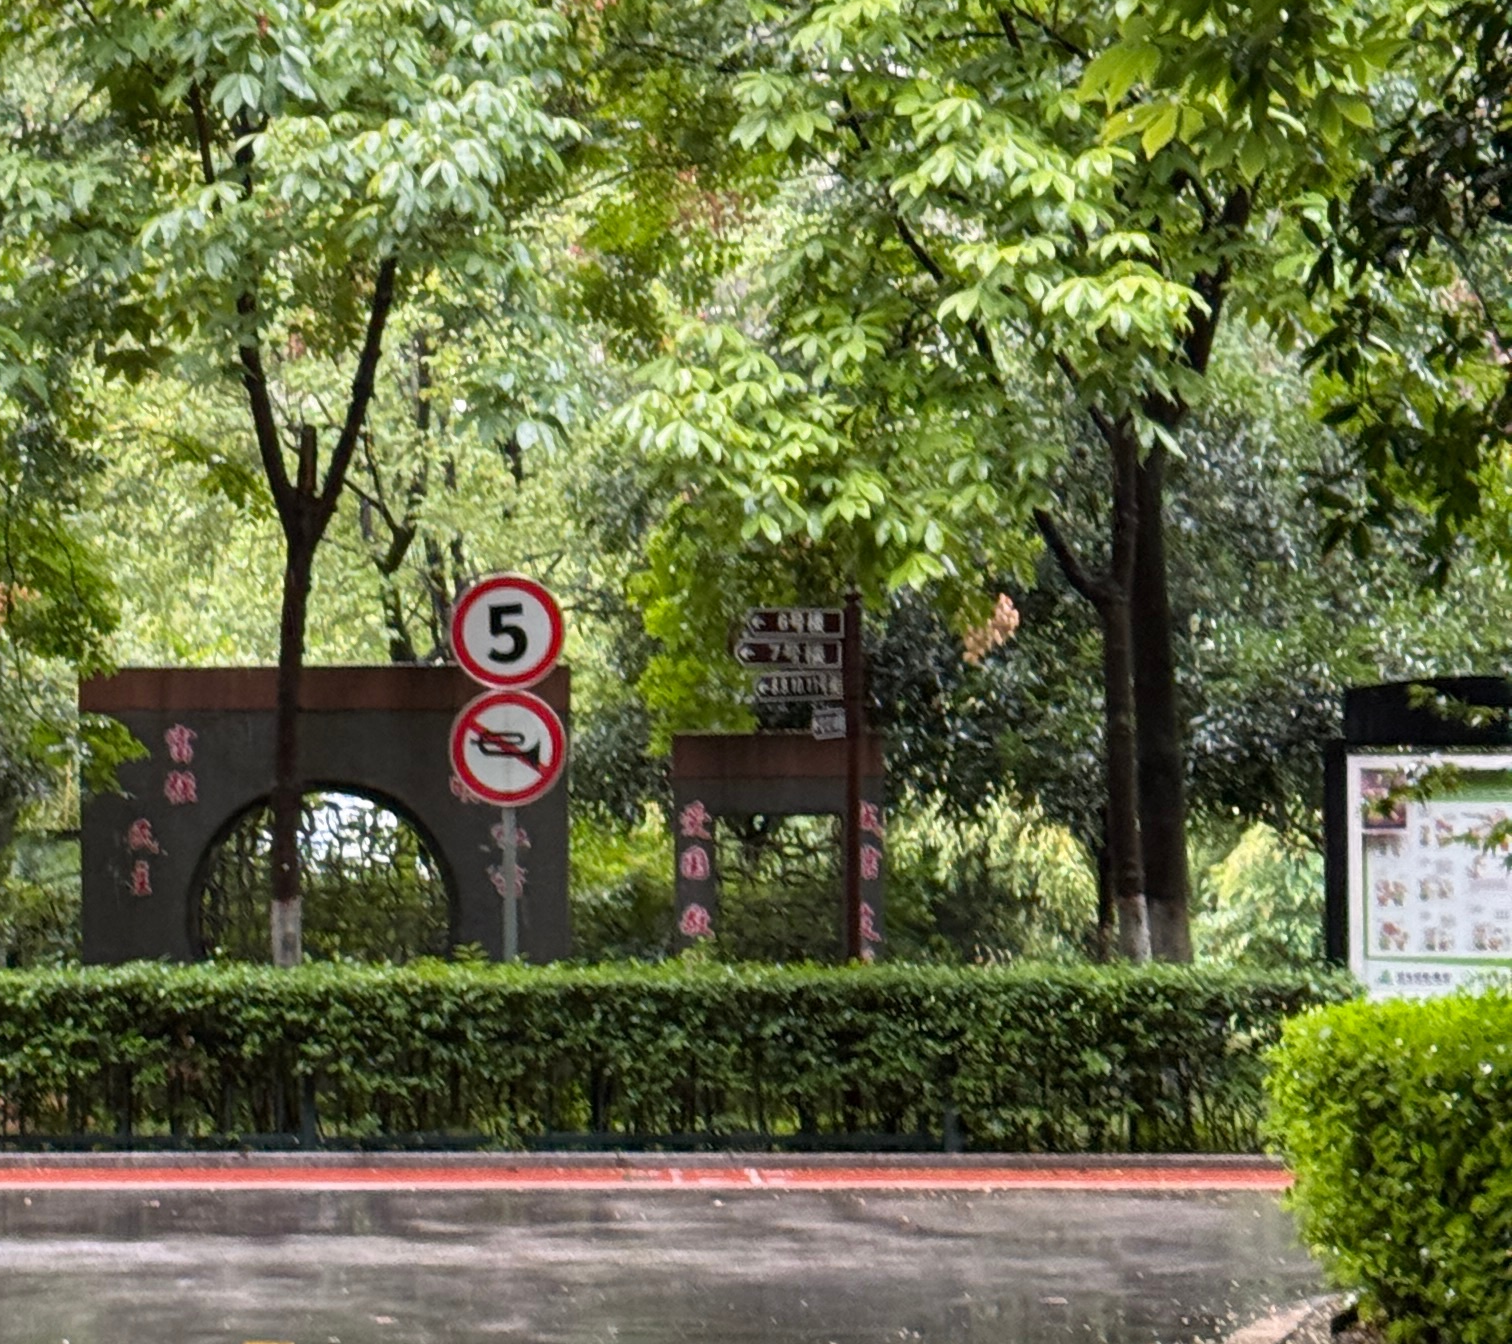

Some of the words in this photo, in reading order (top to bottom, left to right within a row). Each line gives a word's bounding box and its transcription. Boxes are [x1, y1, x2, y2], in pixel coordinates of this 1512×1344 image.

[488, 603, 528, 664] 5
[164, 723, 198, 804] 富强
[679, 799, 712, 880] 爱国
